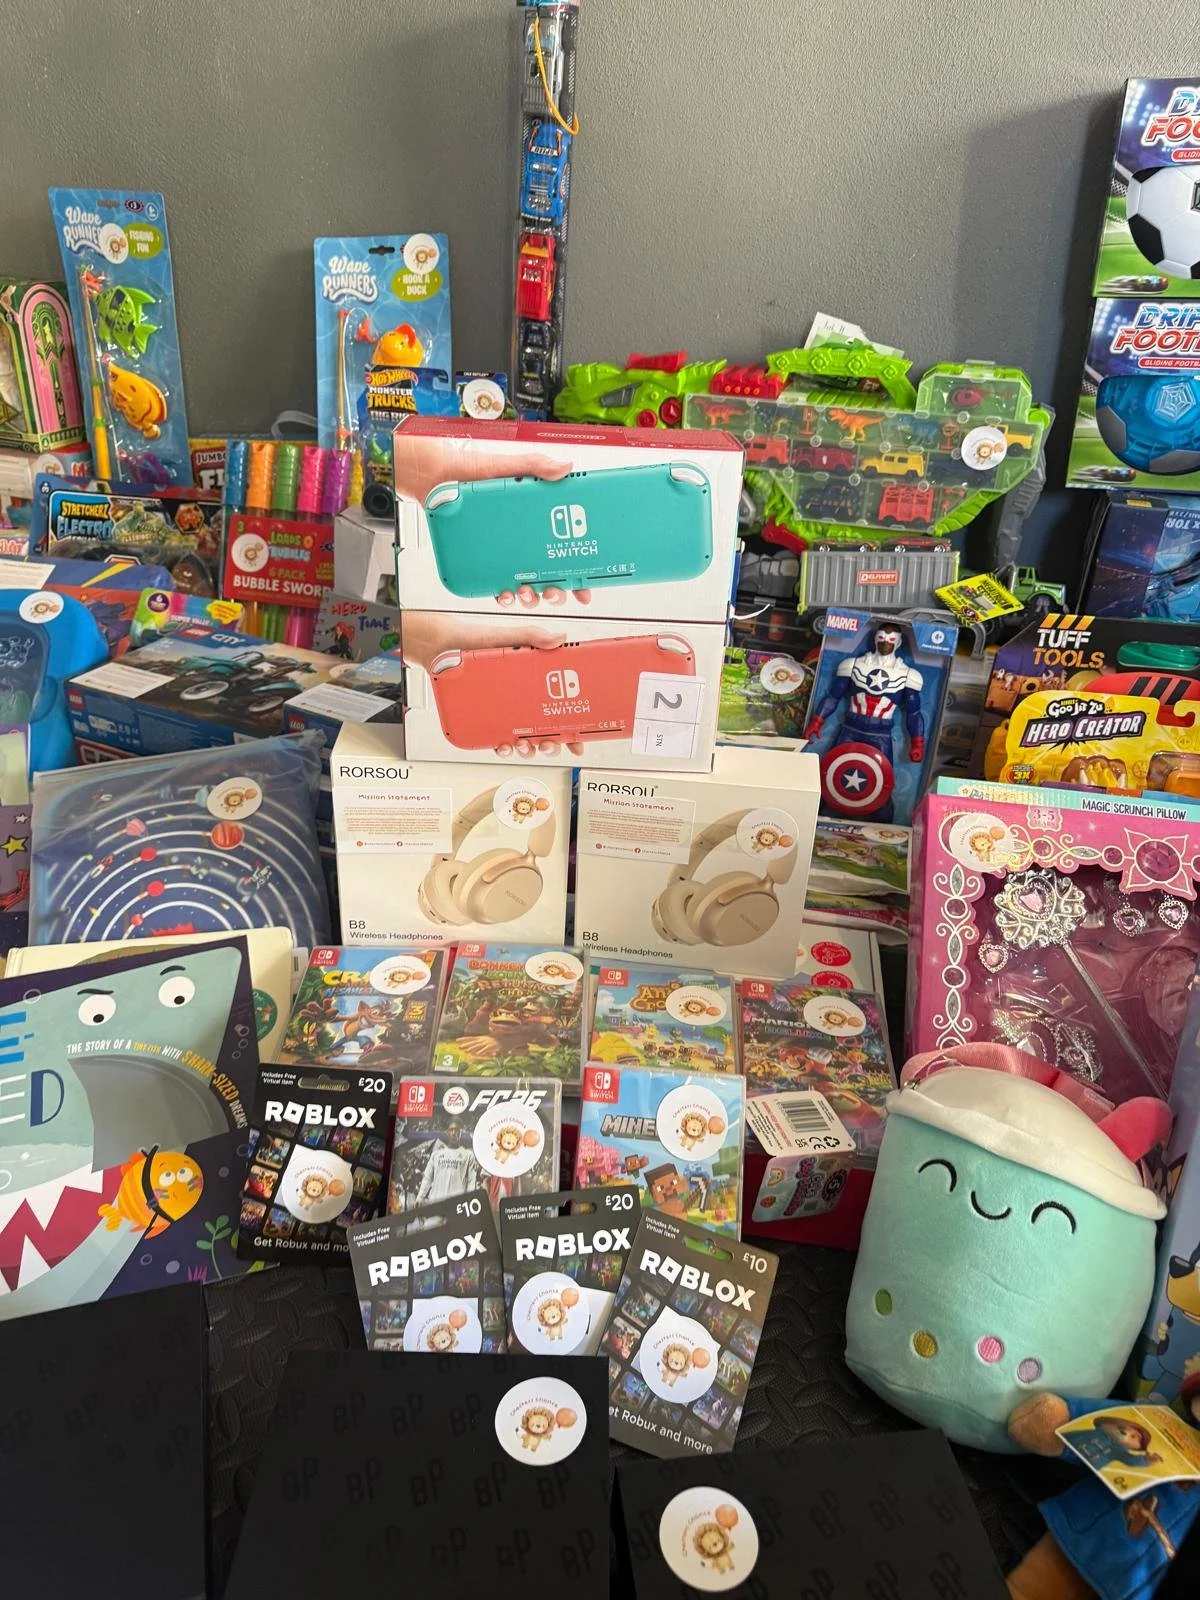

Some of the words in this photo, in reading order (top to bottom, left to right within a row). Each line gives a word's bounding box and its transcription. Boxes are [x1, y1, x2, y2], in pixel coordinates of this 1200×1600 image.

[65, 206, 101, 225] Wave
[63, 225, 101, 252] RUNNE
[329, 256, 371, 273] Wave
[403, 274, 423, 284] HOOK
[323, 275, 378, 304] RUNNERS
[407, 286, 427, 295] DUCK
[1136, 306, 1200, 329] DRIF
[1144, 359, 1173, 367] GLIDING
[369, 387, 412, 395] MONSTER
[367, 395, 415, 409] TRUCKS
[57, 516, 112, 540] ELECTRO
[547, 540, 598, 549] NINTENDO
[548, 546, 598, 558] SWITCH
[233, 574, 280, 592] BUBBLE
[283, 580, 332, 598] SWORD
[826, 615, 858, 631] MARVEL
[211, 634, 246, 644] CITY
[1037, 629, 1091, 649] TUFF
[1033, 648, 1105, 669] TOOLS
[542, 700, 590, 709] NINTENDO
[654, 691, 682, 710] 2
[543, 705, 590, 716] SWITCH
[1027, 722, 1071, 742] HERO
[1075, 715, 1142, 738] CREATOR
[339, 766, 409, 780] RORSOU
[358, 793, 386, 801] Mission
[603, 798, 631, 807] Mission
[1031, 809, 1055, 822] 3-5
[1113, 801, 1154, 817] SCRUNCH
[349, 920, 366, 929] B8
[350, 931, 387, 939] Wireless
[389, 932, 443, 941] Headphones
[582, 931, 599, 941] B8
[582, 942, 618, 953] Wireless
[620, 946, 673, 959] Headphones
[443, 1055, 453, 1066] 3
[66, 1042, 82, 1054] THE
[85, 1039, 111, 1051] STORY
[113, 1039, 125, 1050] OF
[125, 1039, 132, 1050] A
[162, 1045, 183, 1060] WITH
[229, 1099, 248, 1129] DREAMS
[359, 1078, 385, 1093] £20
[449, 1093, 464, 1102] EA
[265, 1101, 376, 1128] ROBLOX
[456, 1198, 481, 1218] £10
[505, 1206, 528, 1214] Includes
[606, 1193, 634, 1211] £20
[645, 1216, 667, 1231] Includes
[667, 1224, 680, 1234] Free
[646, 1223, 663, 1235] Virtual
[664, 1230, 676, 1239] Item
[254, 1236, 272, 1247] Get
[276, 1238, 308, 1250] Robux
[311, 1240, 330, 1251] and
[333, 1243, 349, 1252] mo
[353, 1230, 377, 1242] Includes
[357, 1238, 375, 1247] Virtual
[377, 1233, 390, 1241] Item
[516, 1228, 631, 1261] ROBLOX
[368, 1232, 487, 1286] ROBLOX
[743, 1253, 767, 1273] £10
[639, 1249, 756, 1311] ROBLOX
[609, 1407, 619, 1417] et
[622, 1410, 657, 1432] Robux
[660, 1425, 681, 1442] and
[684, 1438, 713, 1455] more
